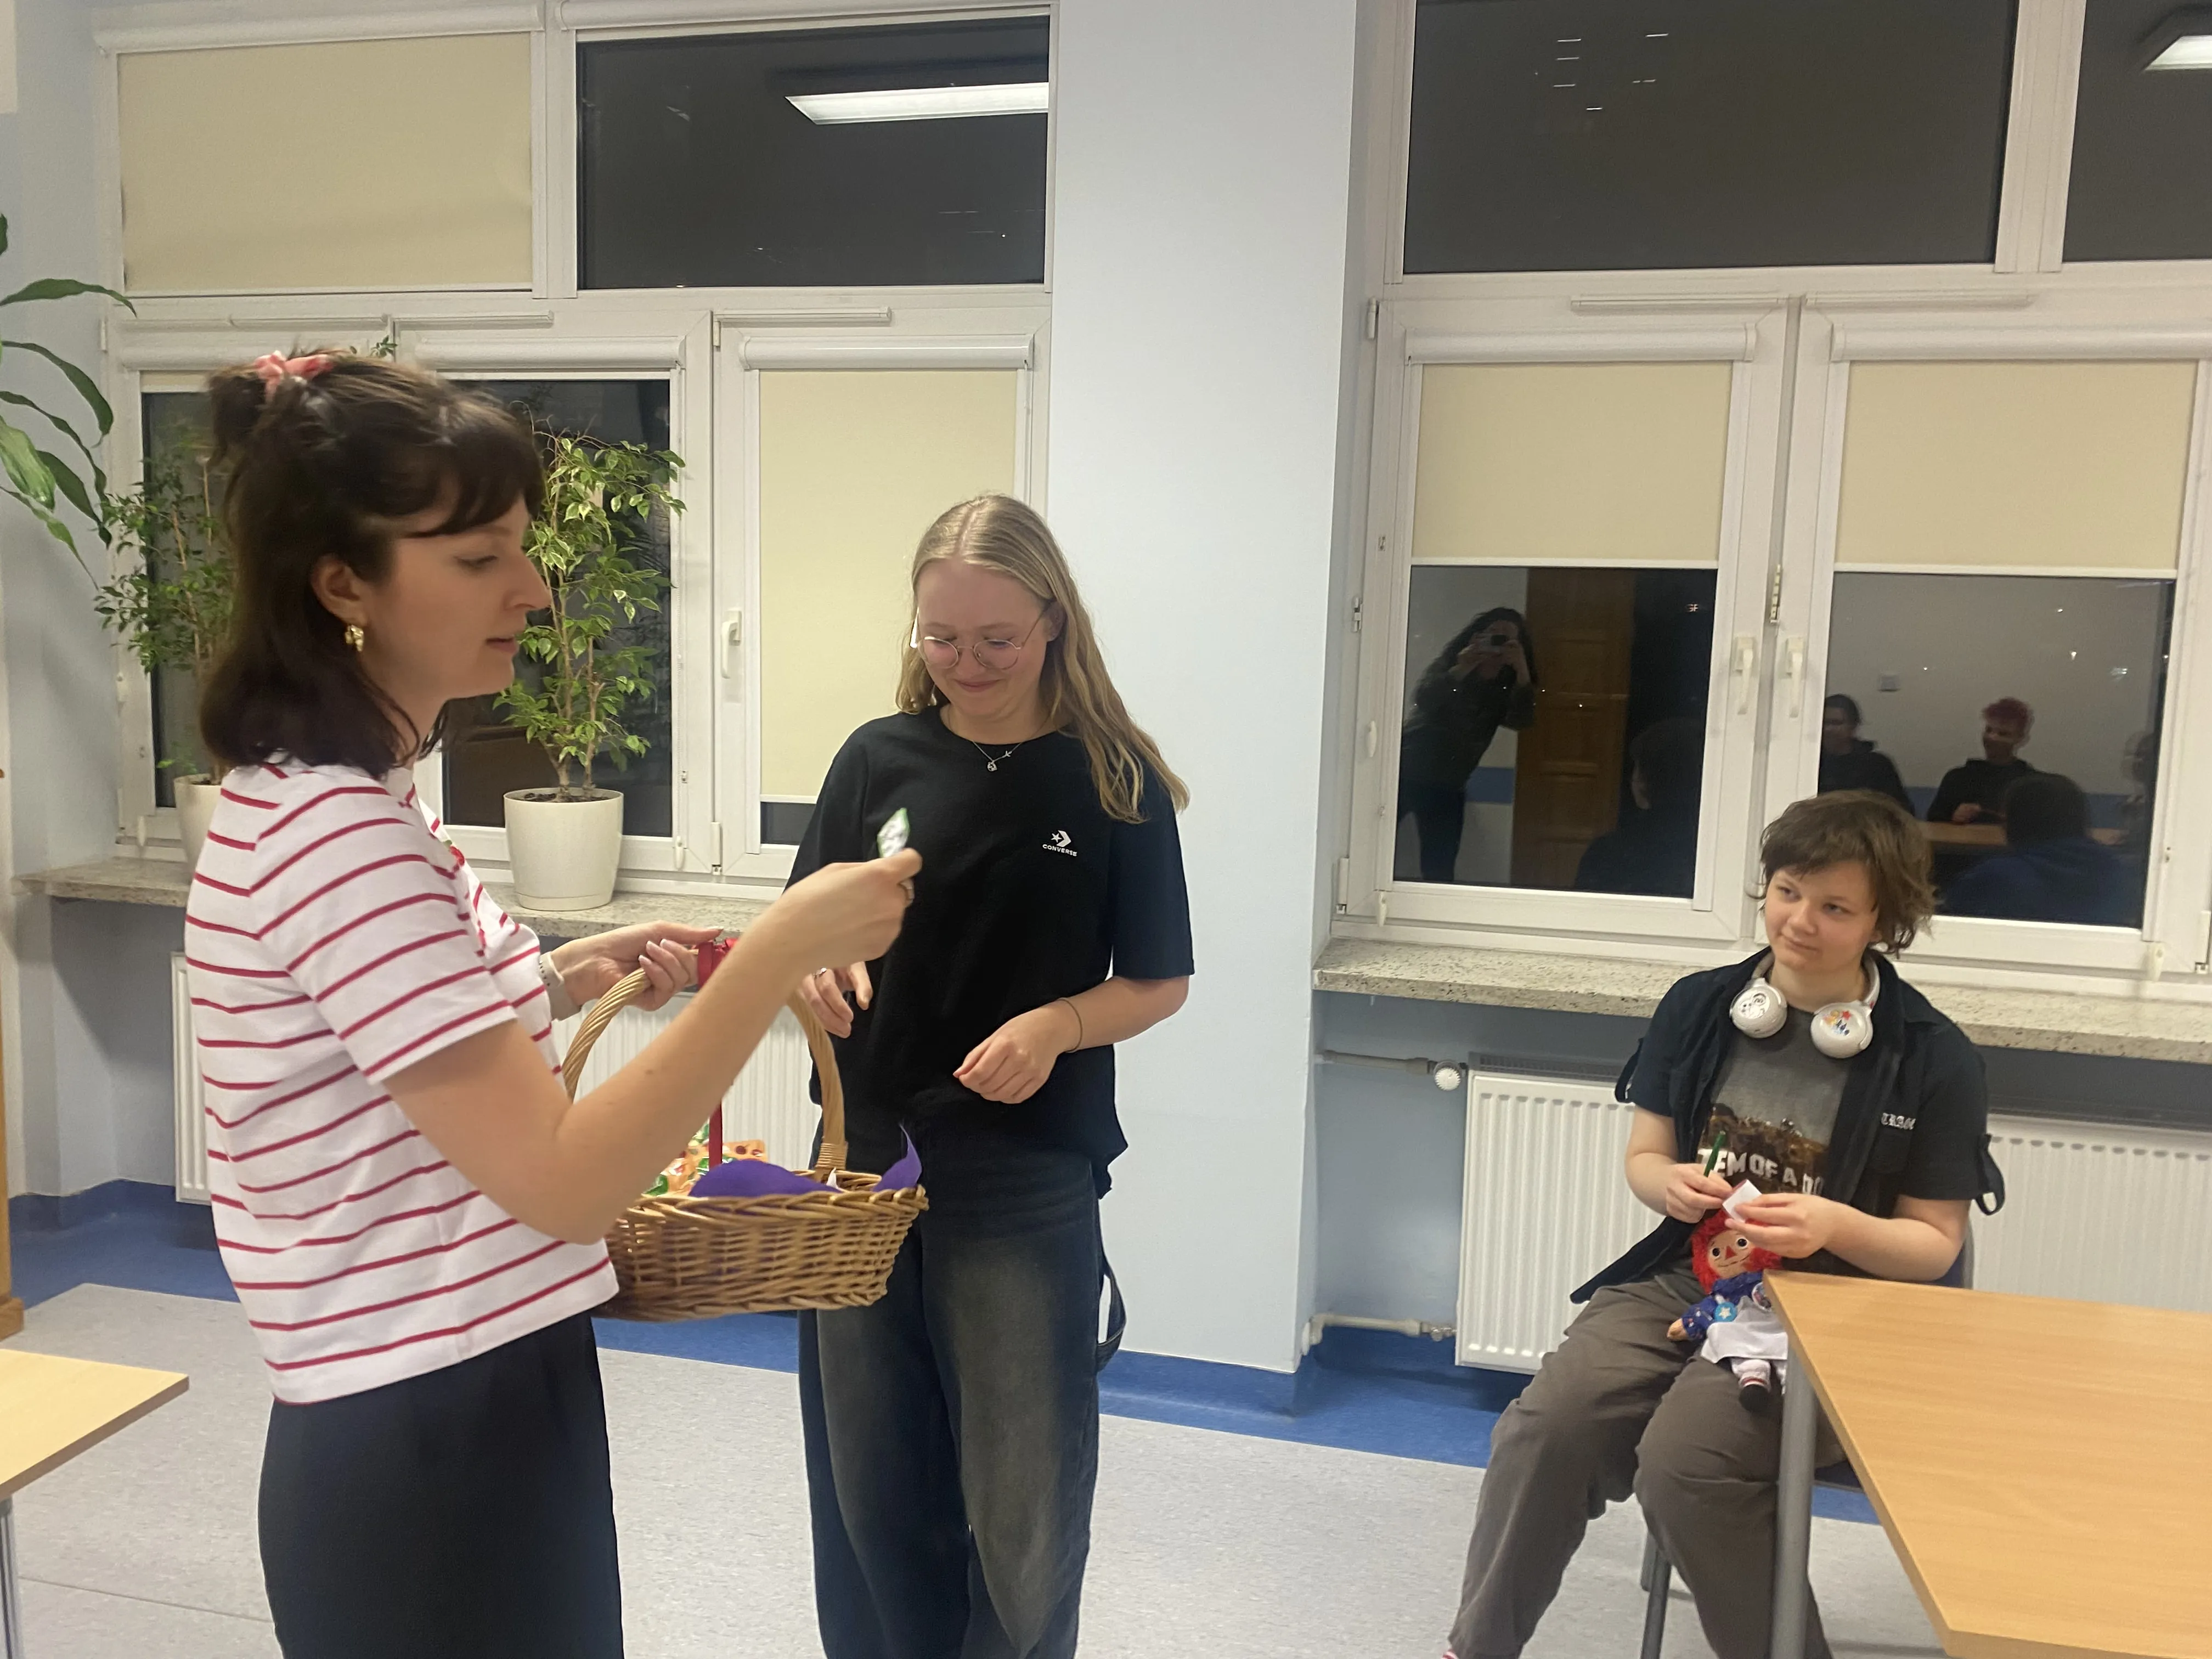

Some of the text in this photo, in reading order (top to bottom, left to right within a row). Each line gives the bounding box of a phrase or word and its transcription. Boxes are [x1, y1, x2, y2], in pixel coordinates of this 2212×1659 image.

[1042, 844, 1077, 856] CONVERSE
[1749, 1154, 1778, 1179] OF
[1782, 1167, 1798, 1186] A
